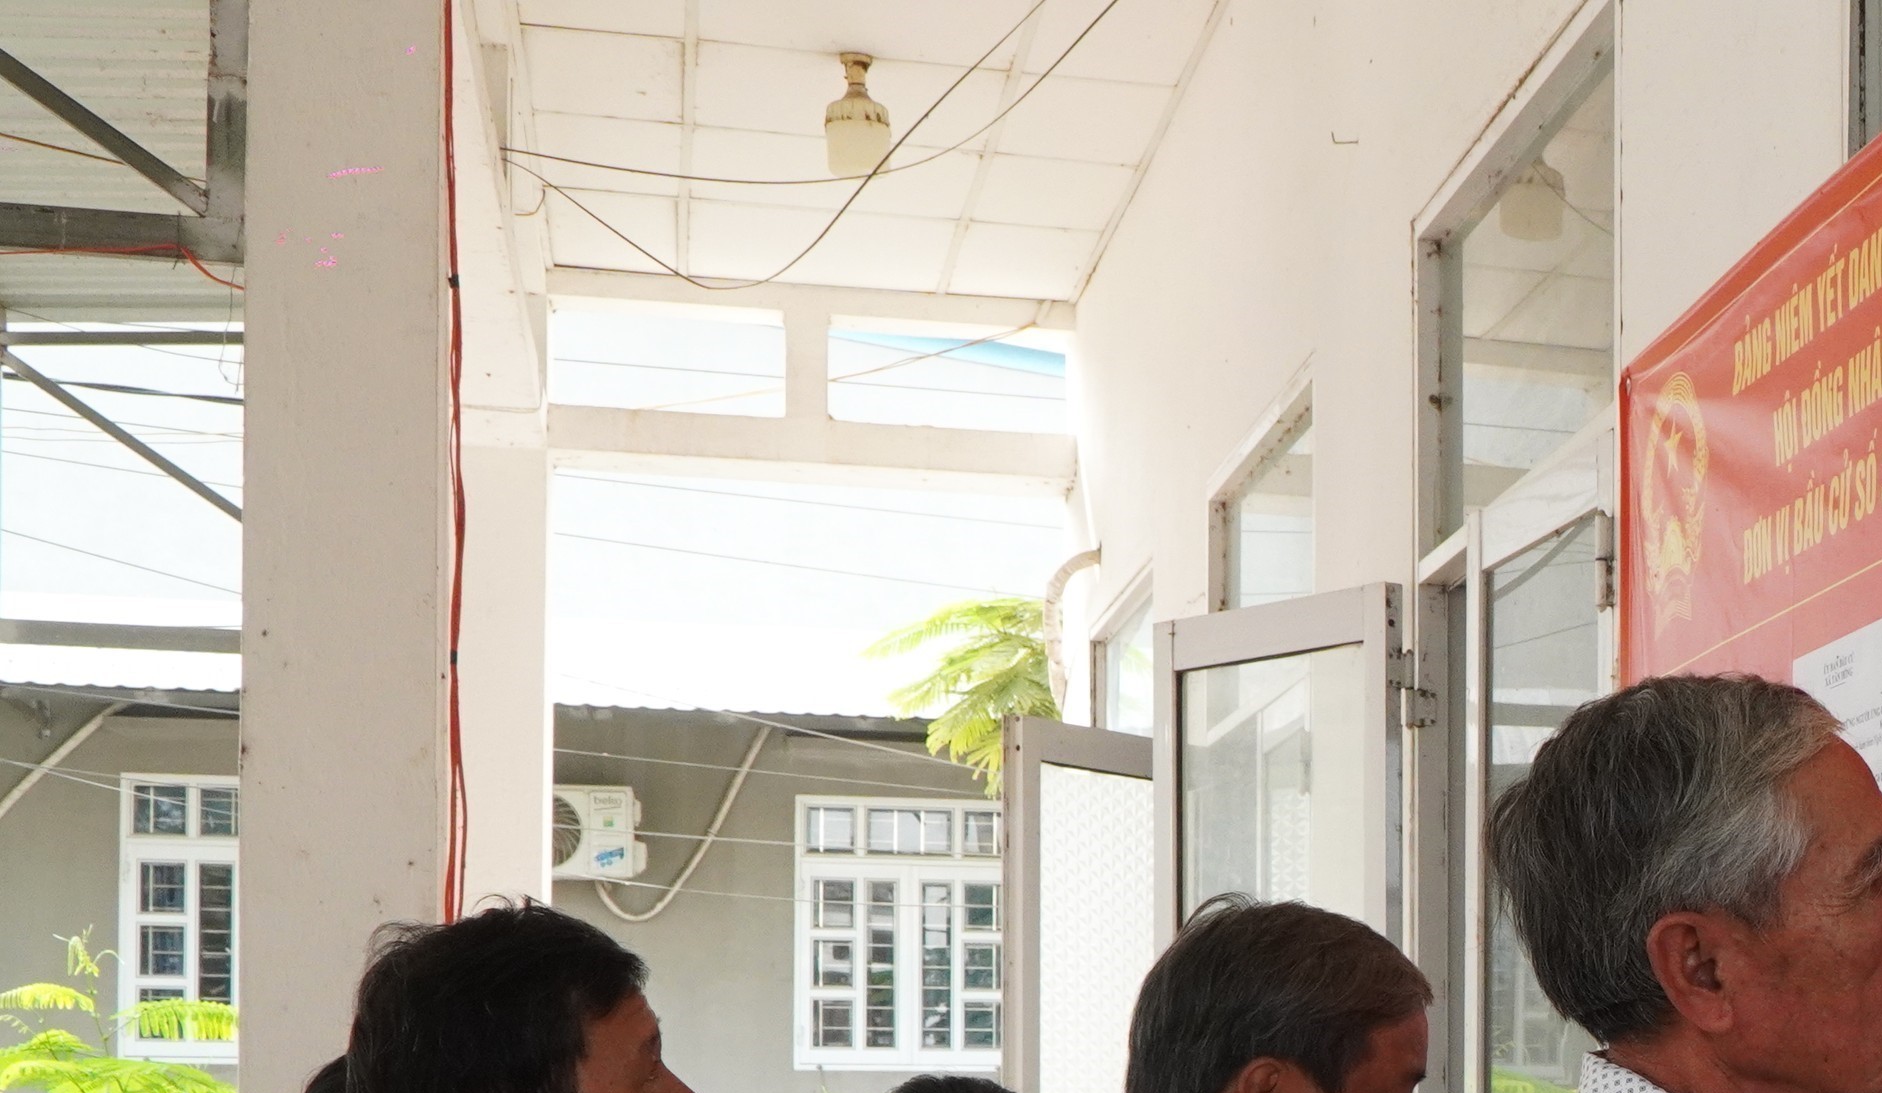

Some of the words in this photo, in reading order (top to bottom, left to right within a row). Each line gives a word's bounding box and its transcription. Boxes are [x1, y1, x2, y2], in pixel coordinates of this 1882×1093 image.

[1732, 314, 1772, 397] BẢNG
[1775, 282, 1814, 366] NIÊM
[1816, 243, 1846, 333] YẾT
[1773, 389, 1799, 474] HỘI
[1801, 360, 1844, 449] ĐỒNG
[1743, 515, 1772, 585] ĐƠN
[1775, 504, 1790, 575] VỊ
[1793, 470, 1825, 556] BẦU
[1828, 448, 1852, 536] CỬ
[1854, 427, 1877, 522] SỐ
